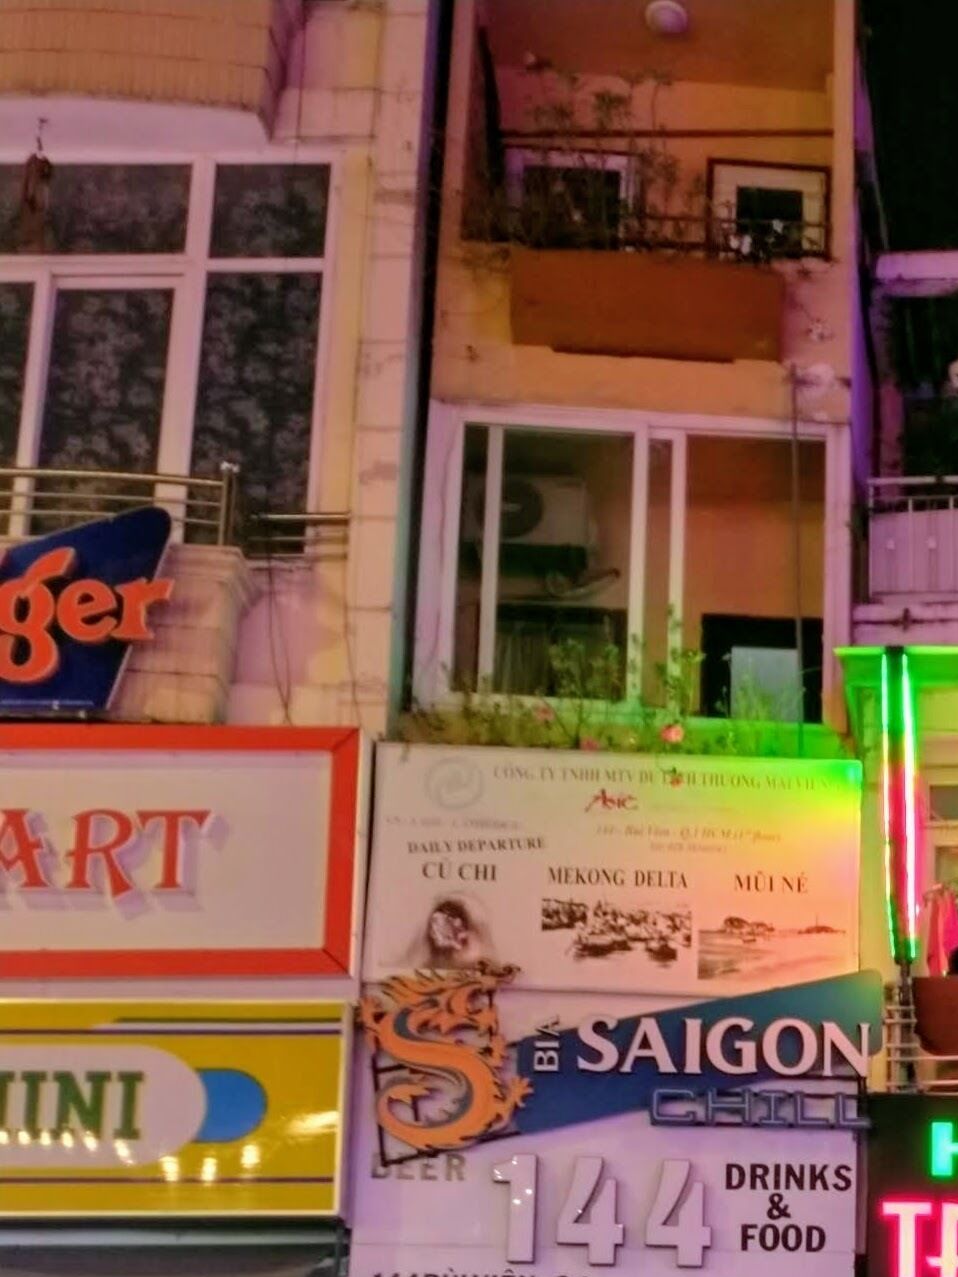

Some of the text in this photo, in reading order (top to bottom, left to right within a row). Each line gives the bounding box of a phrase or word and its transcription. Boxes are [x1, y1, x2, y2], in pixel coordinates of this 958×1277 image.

[407, 838, 544, 854] DAILY DEPARTURE
[457, 862, 497, 881] CHI
[549, 866, 688, 891] MEKONG DELTA
[533, 1015, 560, 1072] BIA
[577, 1014, 870, 1077] SAIGON
[650, 1085, 873, 1129] CHILL
[725, 1163, 853, 1192] DRINKS
[491, 1153, 713, 1268] 144
[766, 1193, 791, 1221] &
[740, 1224, 827, 1252] FOOD
